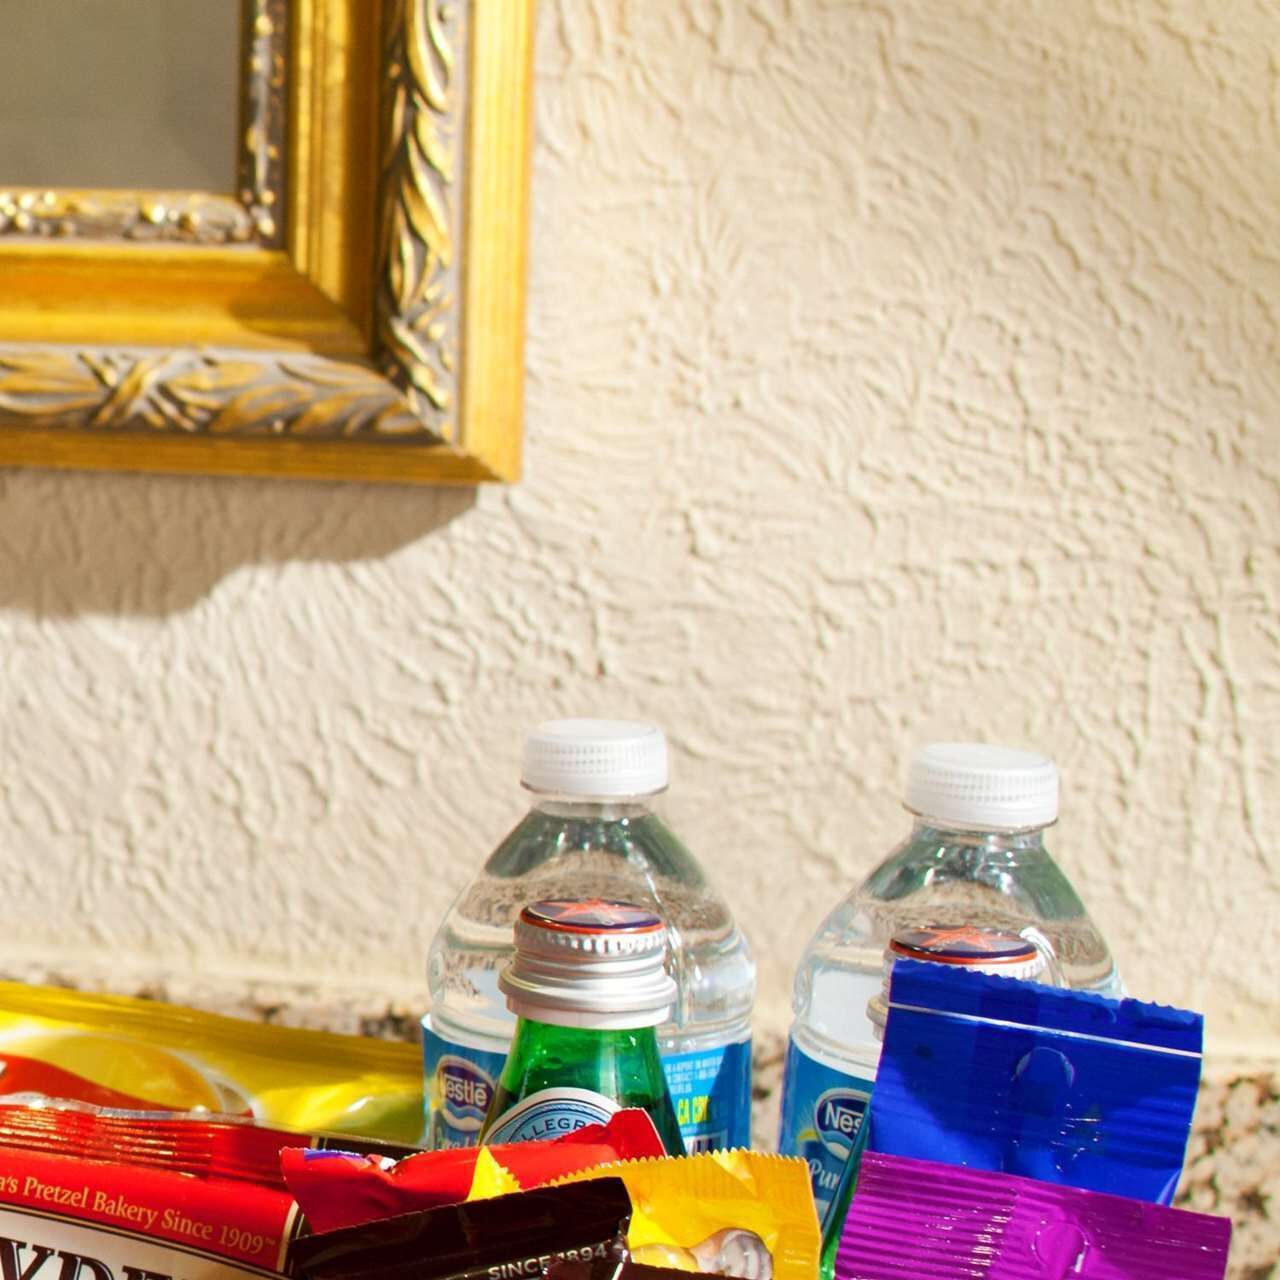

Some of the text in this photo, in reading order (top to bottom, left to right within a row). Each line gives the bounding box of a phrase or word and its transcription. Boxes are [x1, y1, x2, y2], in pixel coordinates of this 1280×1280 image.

[23, 1175, 89, 1211] Pretzel
[92, 1190, 159, 1226] Bakery
[163, 1207, 214, 1239] Since
[219, 1224, 264, 1255] 1909
